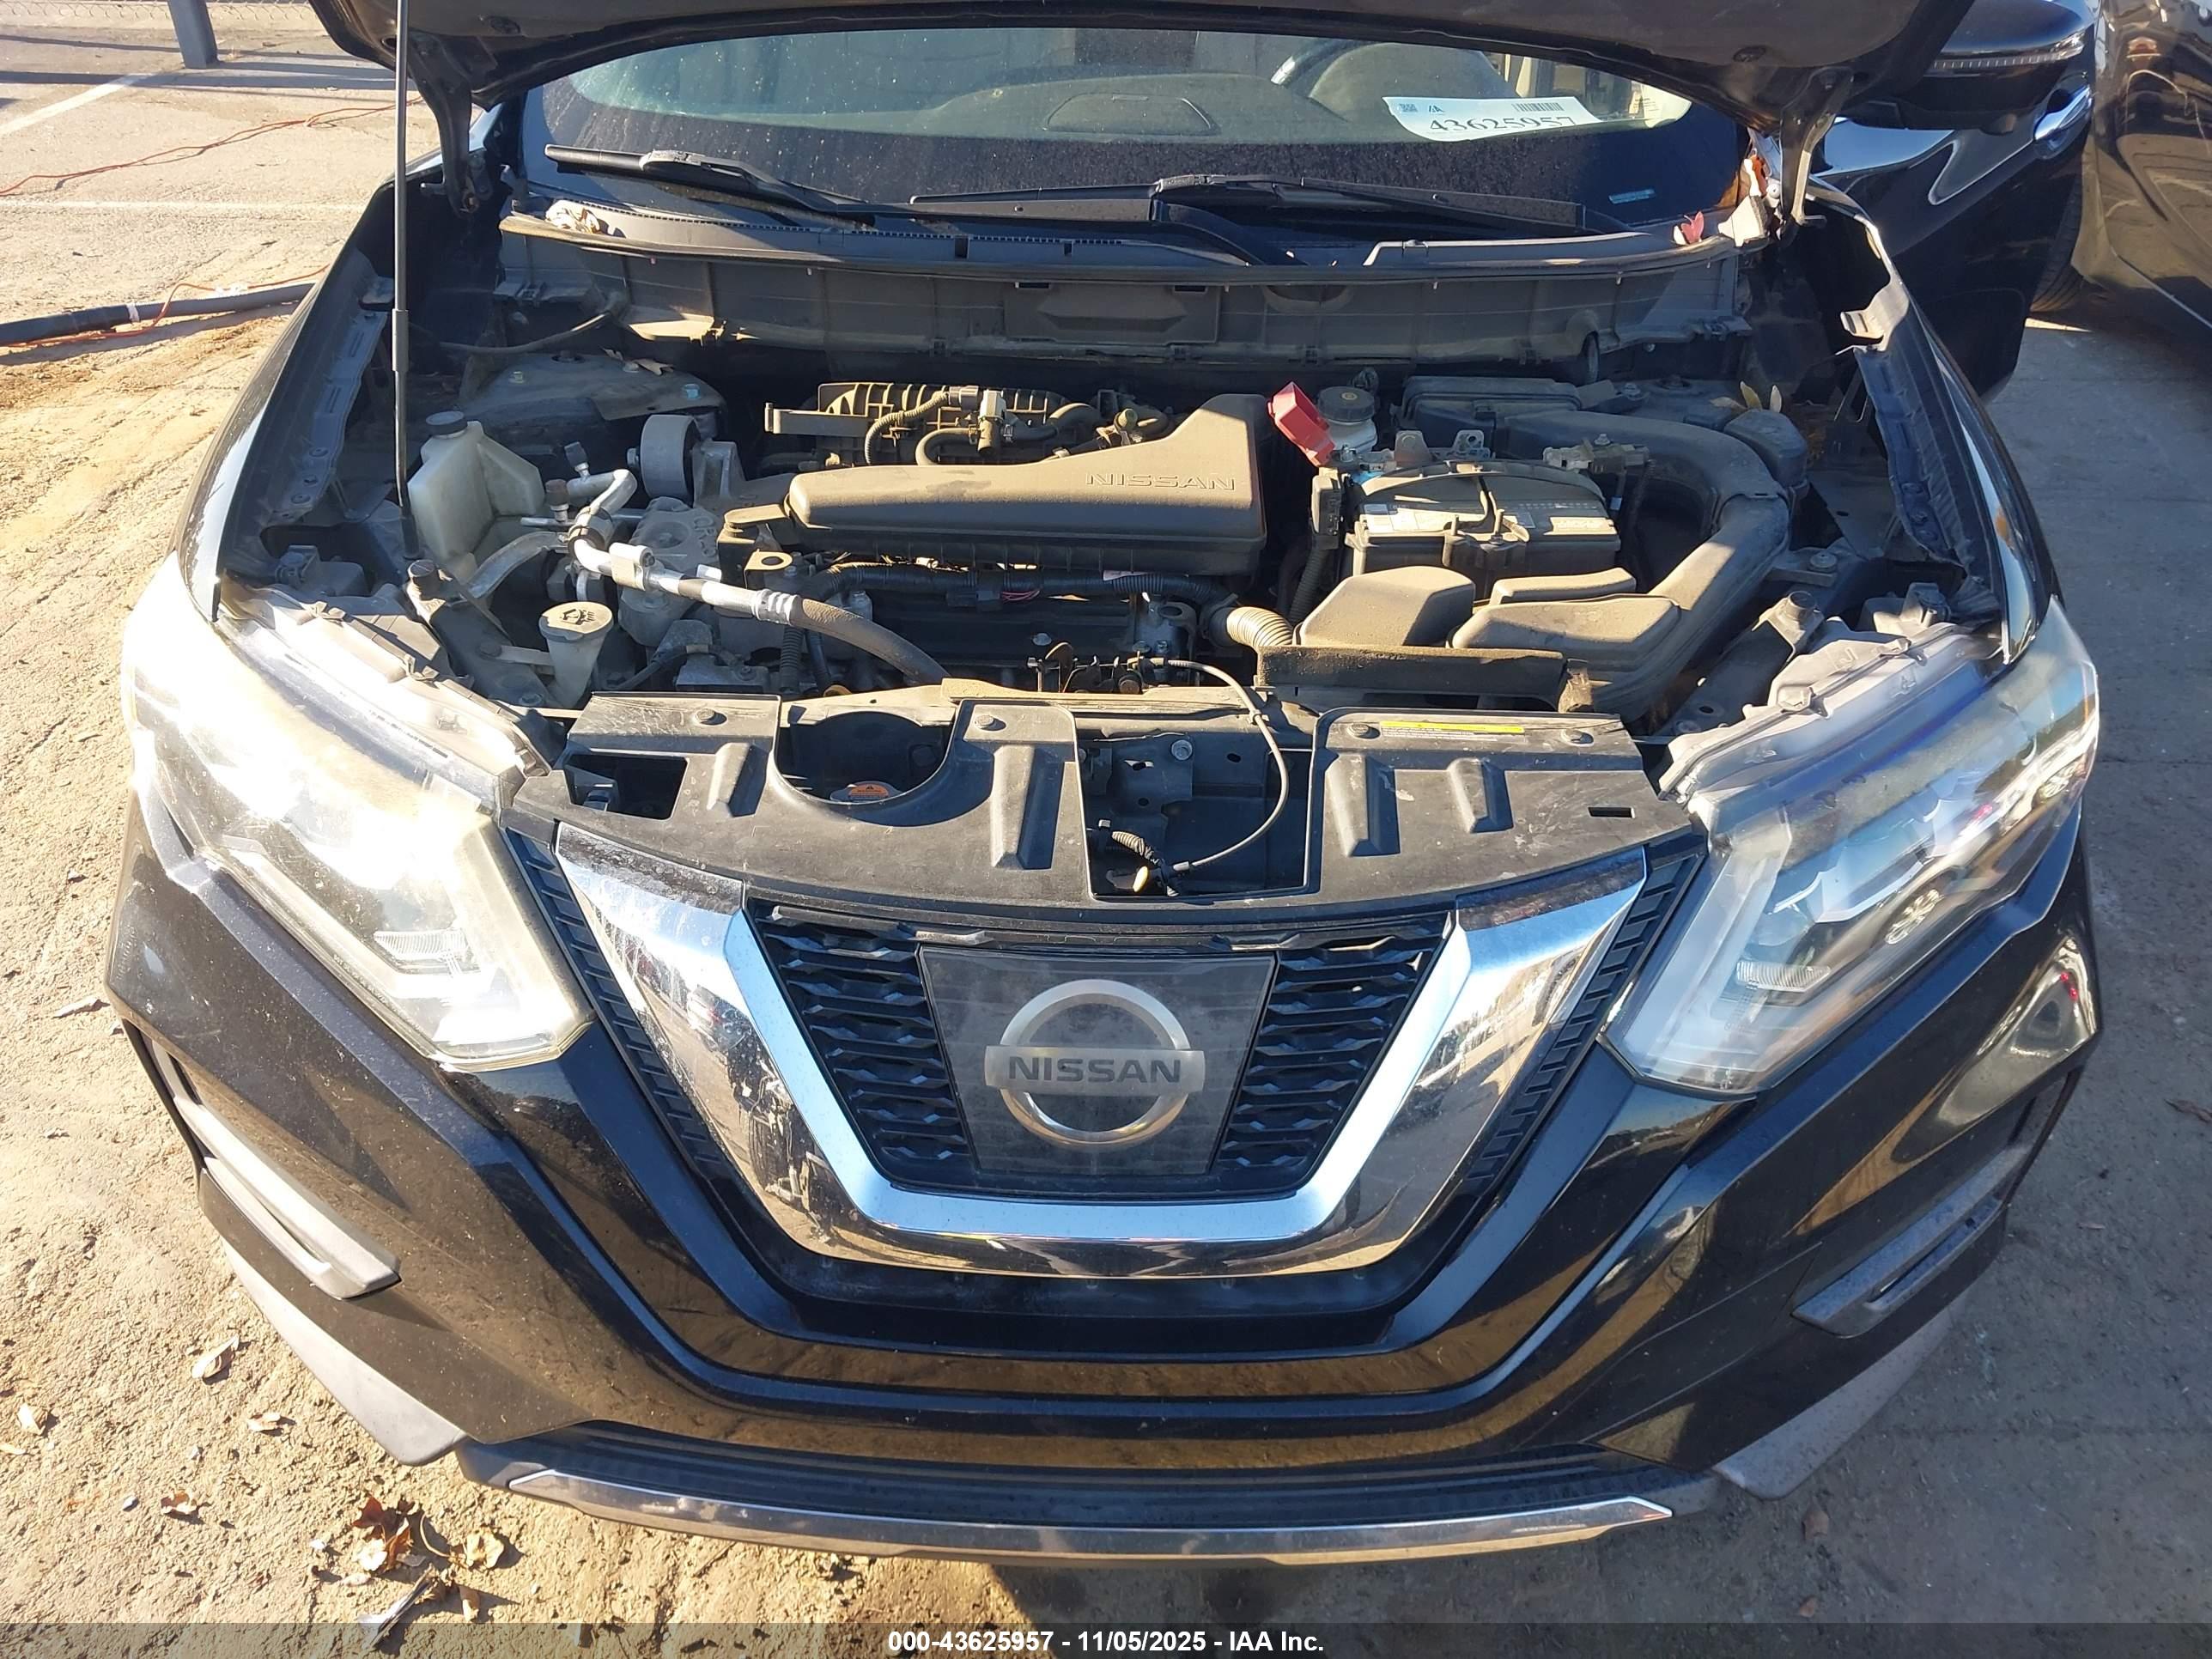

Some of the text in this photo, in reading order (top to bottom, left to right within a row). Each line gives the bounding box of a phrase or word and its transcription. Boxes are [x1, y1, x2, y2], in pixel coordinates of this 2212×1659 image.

[1430, 117, 1575, 131] 43625957
[1086, 473, 1236, 490] NISSAN
[1009, 1056, 1181, 1084] NISSAN
